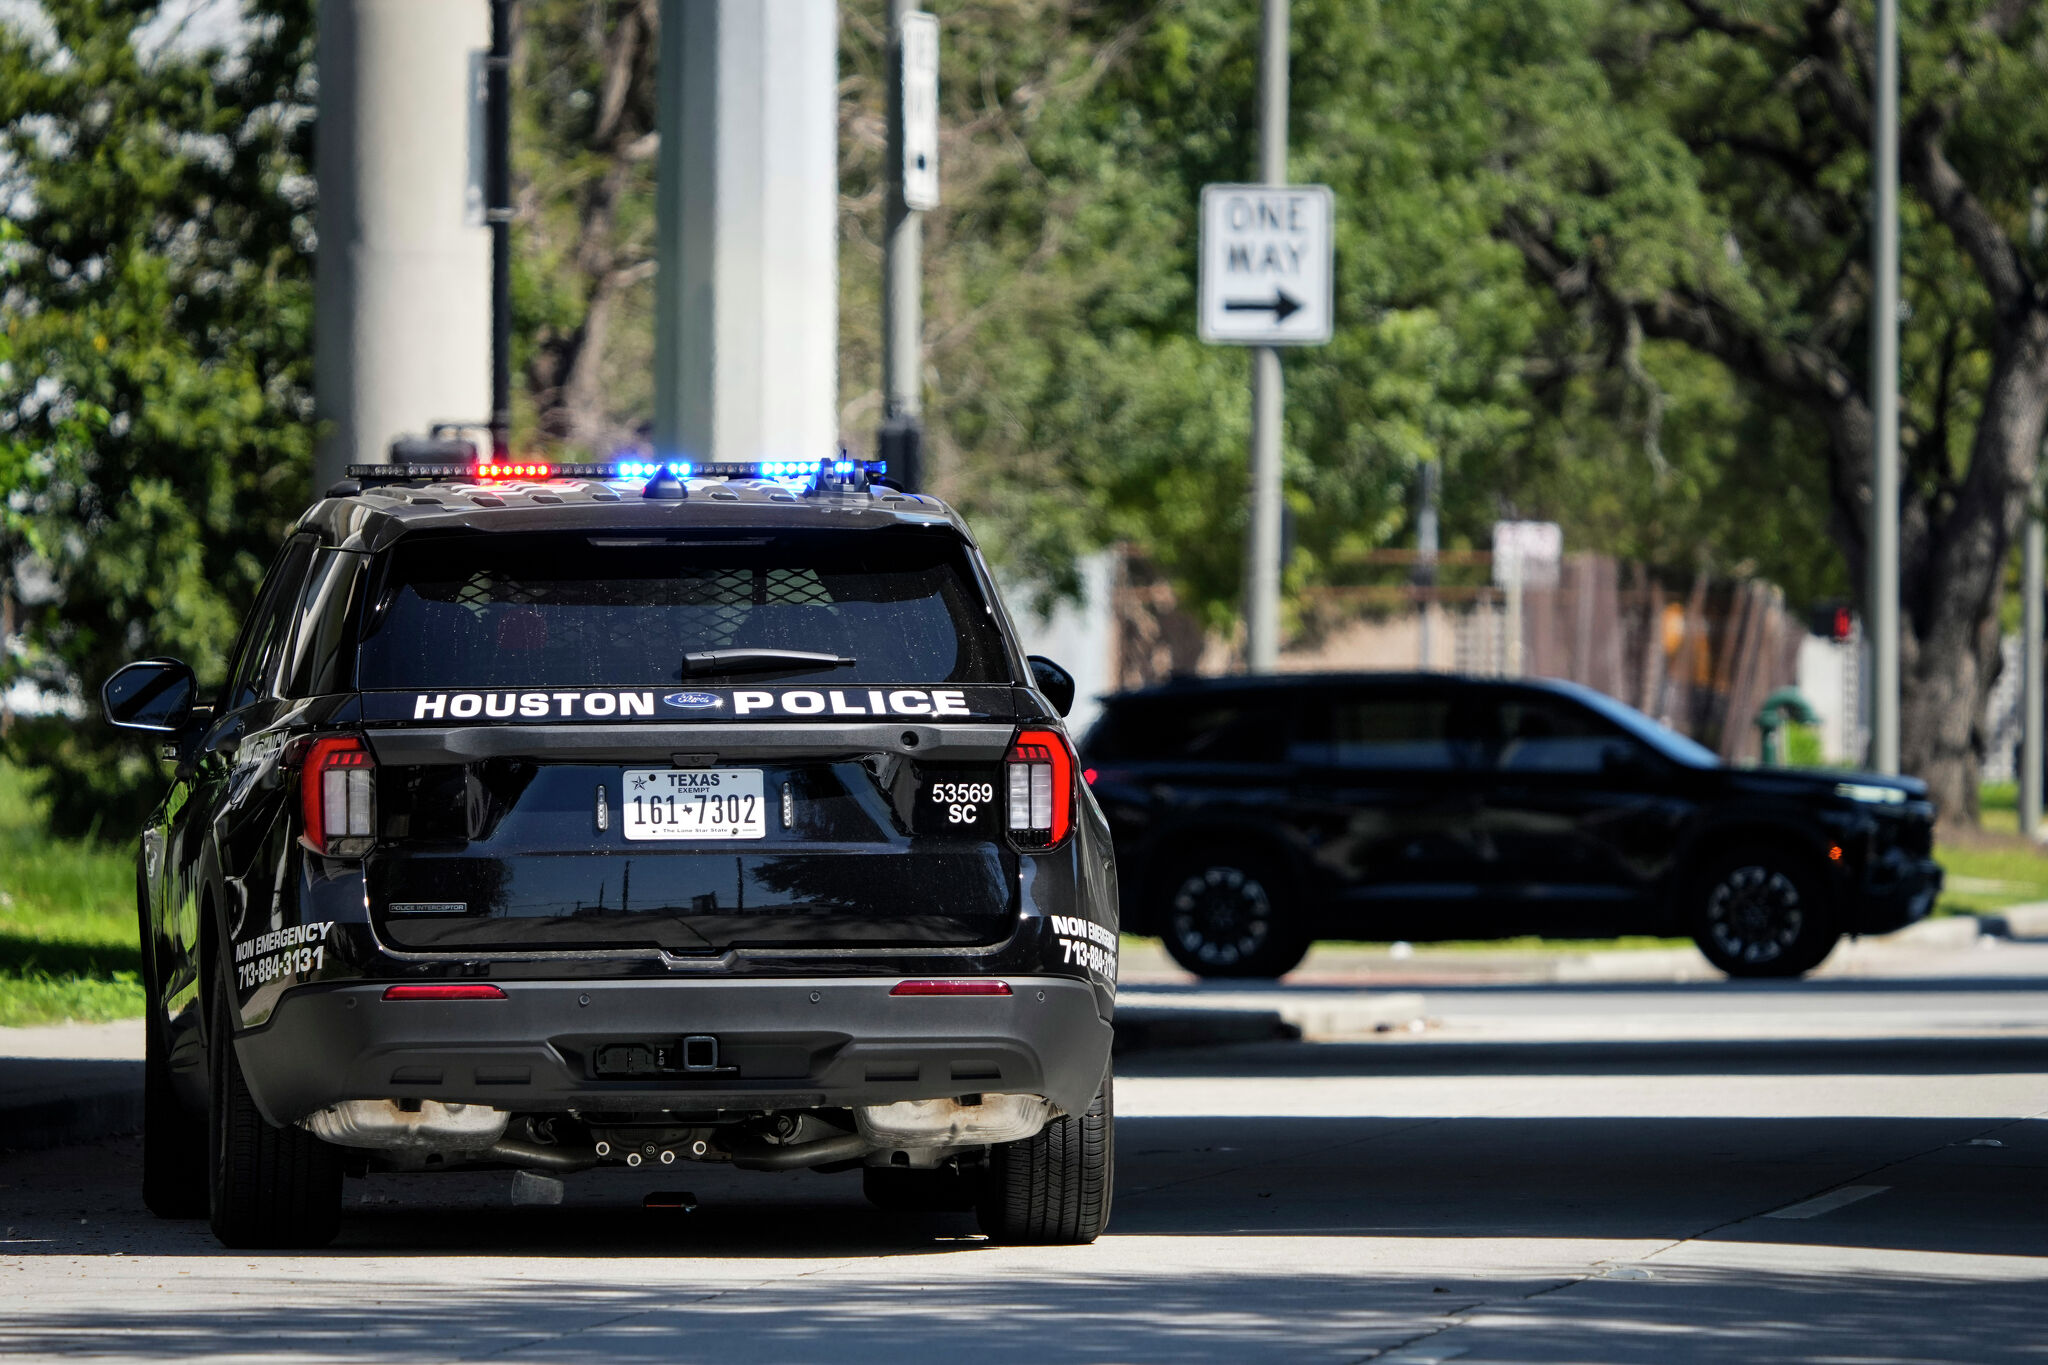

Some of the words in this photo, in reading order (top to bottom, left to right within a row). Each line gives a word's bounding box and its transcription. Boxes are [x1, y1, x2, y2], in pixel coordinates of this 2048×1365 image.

[1225, 197, 1306, 231] ONE
[1226, 242, 1309, 273] WAY
[414, 692, 655, 719] HOUSTON
[733, 690, 970, 715] POLICE
[677, 693, 709, 703] Ford
[667, 773, 720, 786] TEXAS
[932, 783, 993, 803] 53569
[633, 795, 679, 825] 161
[694, 794, 756, 824] 7302
[948, 804, 977, 823] SC
[1050, 915, 1088, 938] NON
[235, 938, 255, 963] NON
[255, 921, 334, 955] EMERGENCY
[238, 945, 325, 990] 713-884-3131
